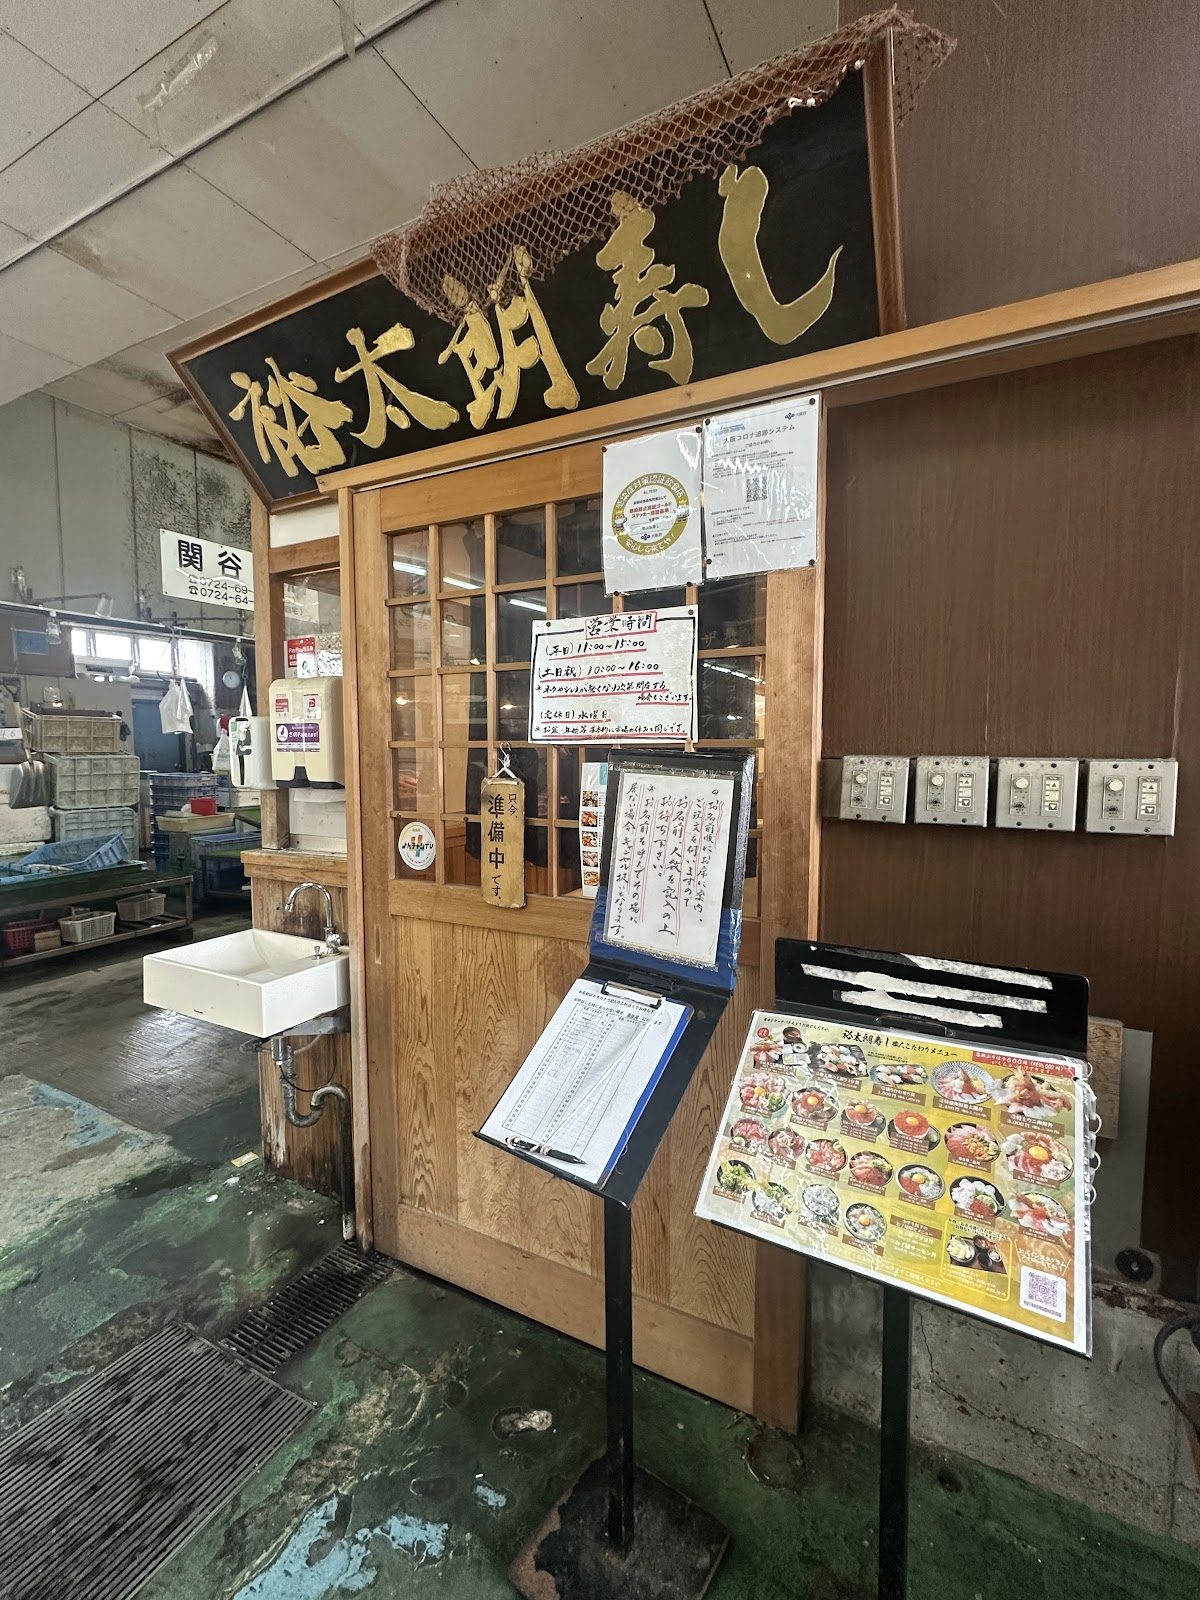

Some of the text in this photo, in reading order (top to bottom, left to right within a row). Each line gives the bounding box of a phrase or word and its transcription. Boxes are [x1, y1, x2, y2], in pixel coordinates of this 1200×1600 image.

[178, 539, 242, 580] 関谷
[587, 614, 652, 636] 営業時間
[487, 794, 505, 900] 準備中です。
